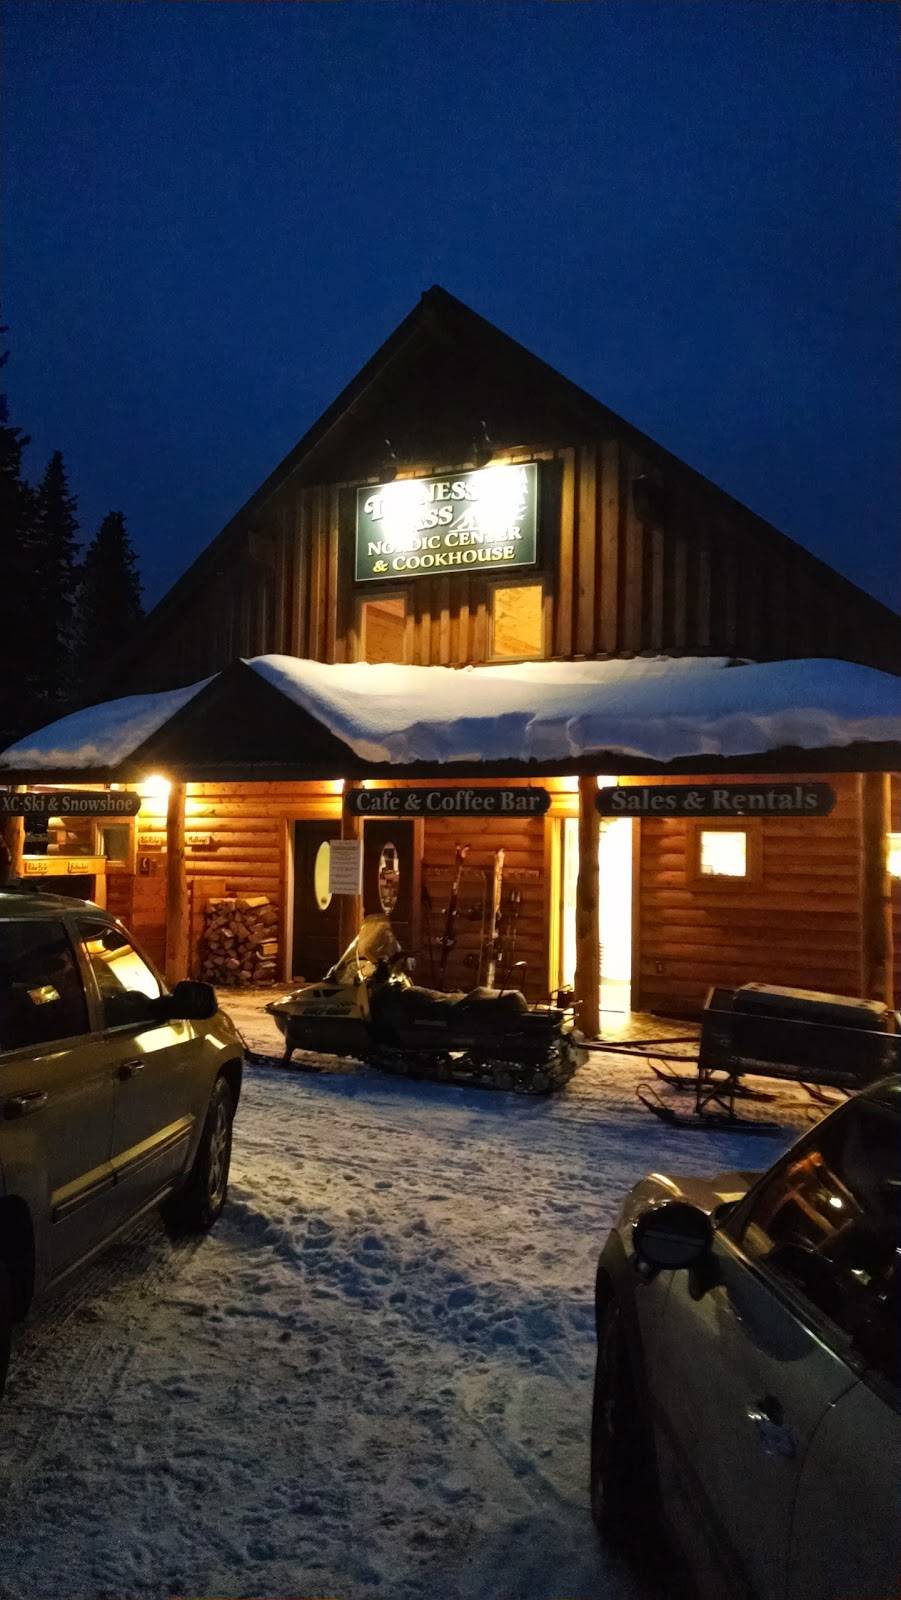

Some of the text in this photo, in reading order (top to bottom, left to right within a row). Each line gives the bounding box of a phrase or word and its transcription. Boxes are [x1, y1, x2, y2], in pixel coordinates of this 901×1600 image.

[368, 526, 522, 556] NODIC CENER
[373, 546, 516, 573] & COOKHOUSE
[48, 796, 60, 811] &
[61, 795, 133, 812] Snowshoe
[356, 790, 540, 811] Cafe & Coffee Bar
[610, 786, 819, 811] Sales & Rentals
